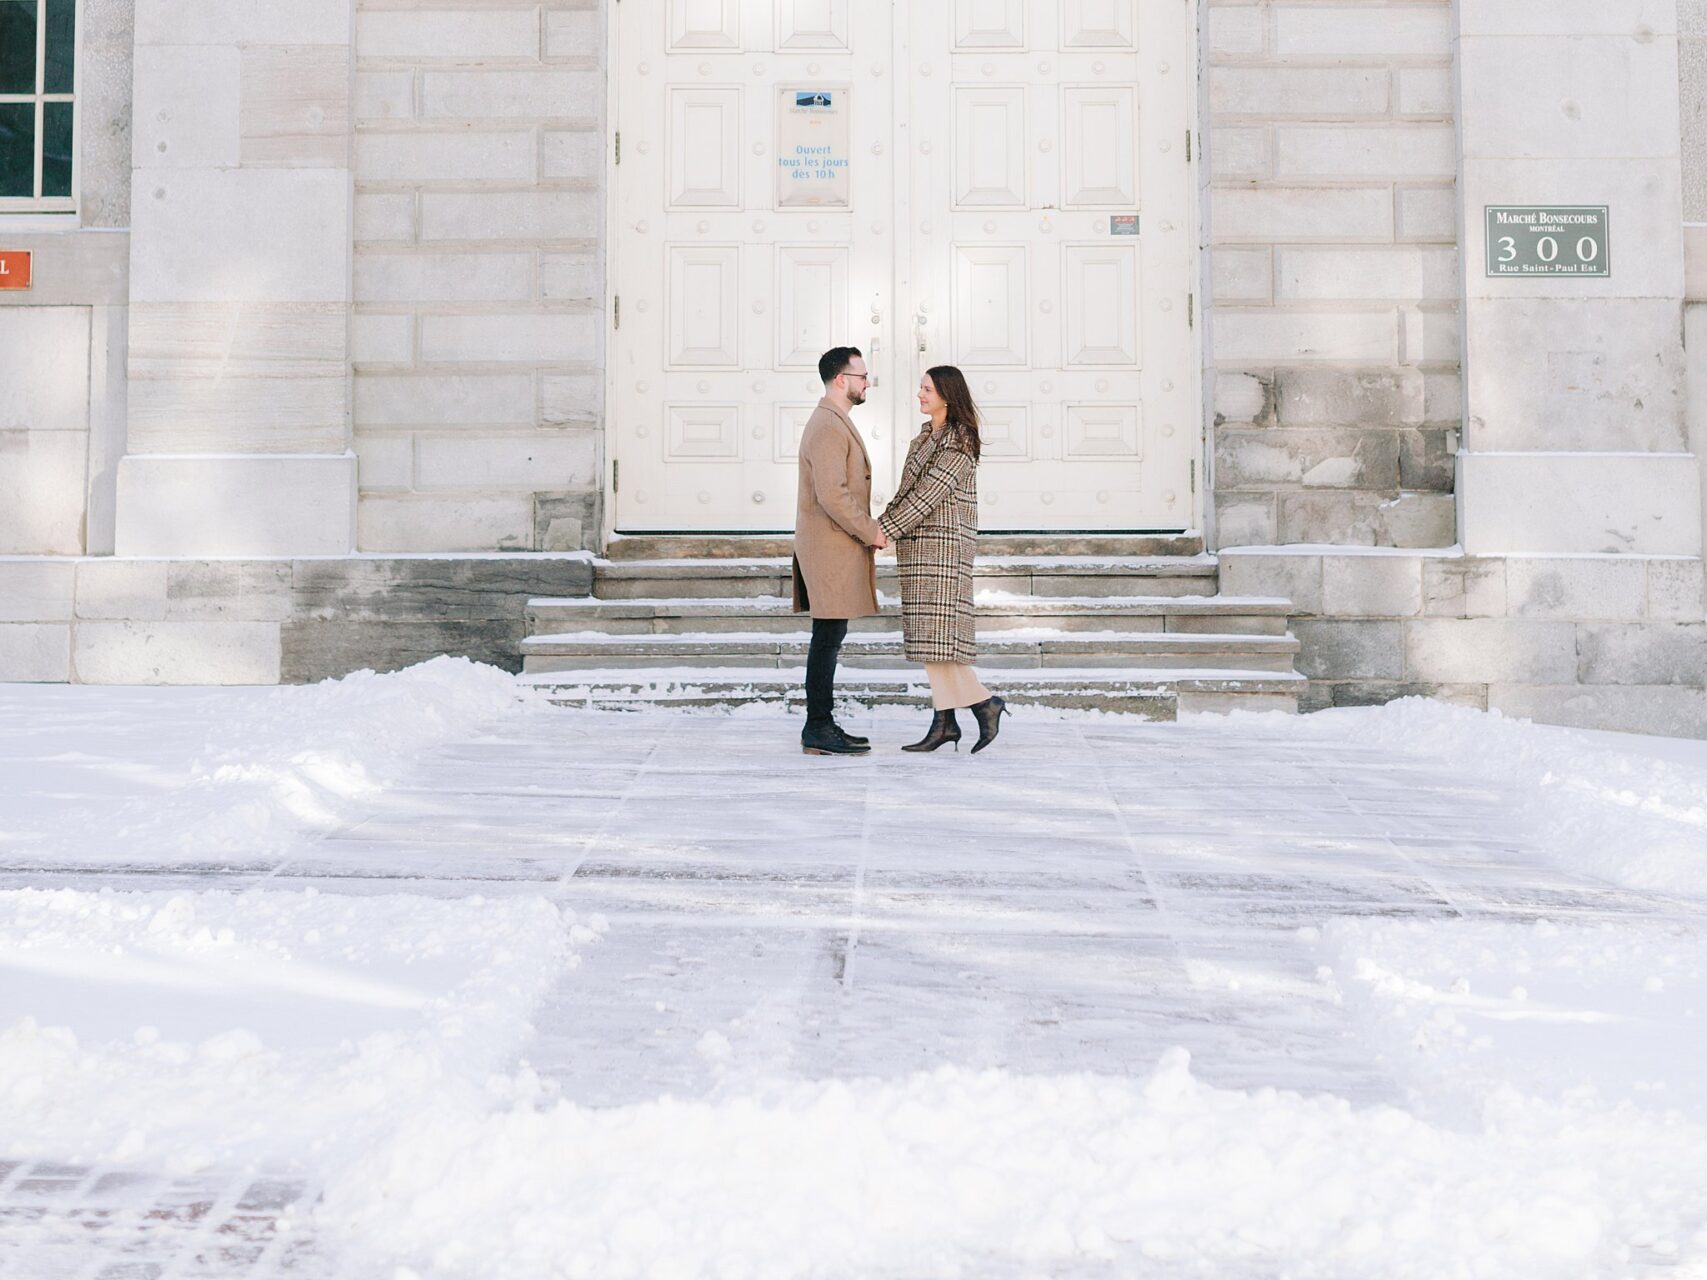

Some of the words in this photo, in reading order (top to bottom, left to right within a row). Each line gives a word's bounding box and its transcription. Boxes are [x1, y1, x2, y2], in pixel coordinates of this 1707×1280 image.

[796, 145, 832, 154] Ouvert
[778, 157, 801, 167] tous
[804, 157, 819, 167] les
[822, 157, 849, 168] jours
[1499, 264, 1519, 272] Rue
[1522, 264, 1577, 272] Saint-Paul
[1581, 264, 1597, 272] Est
